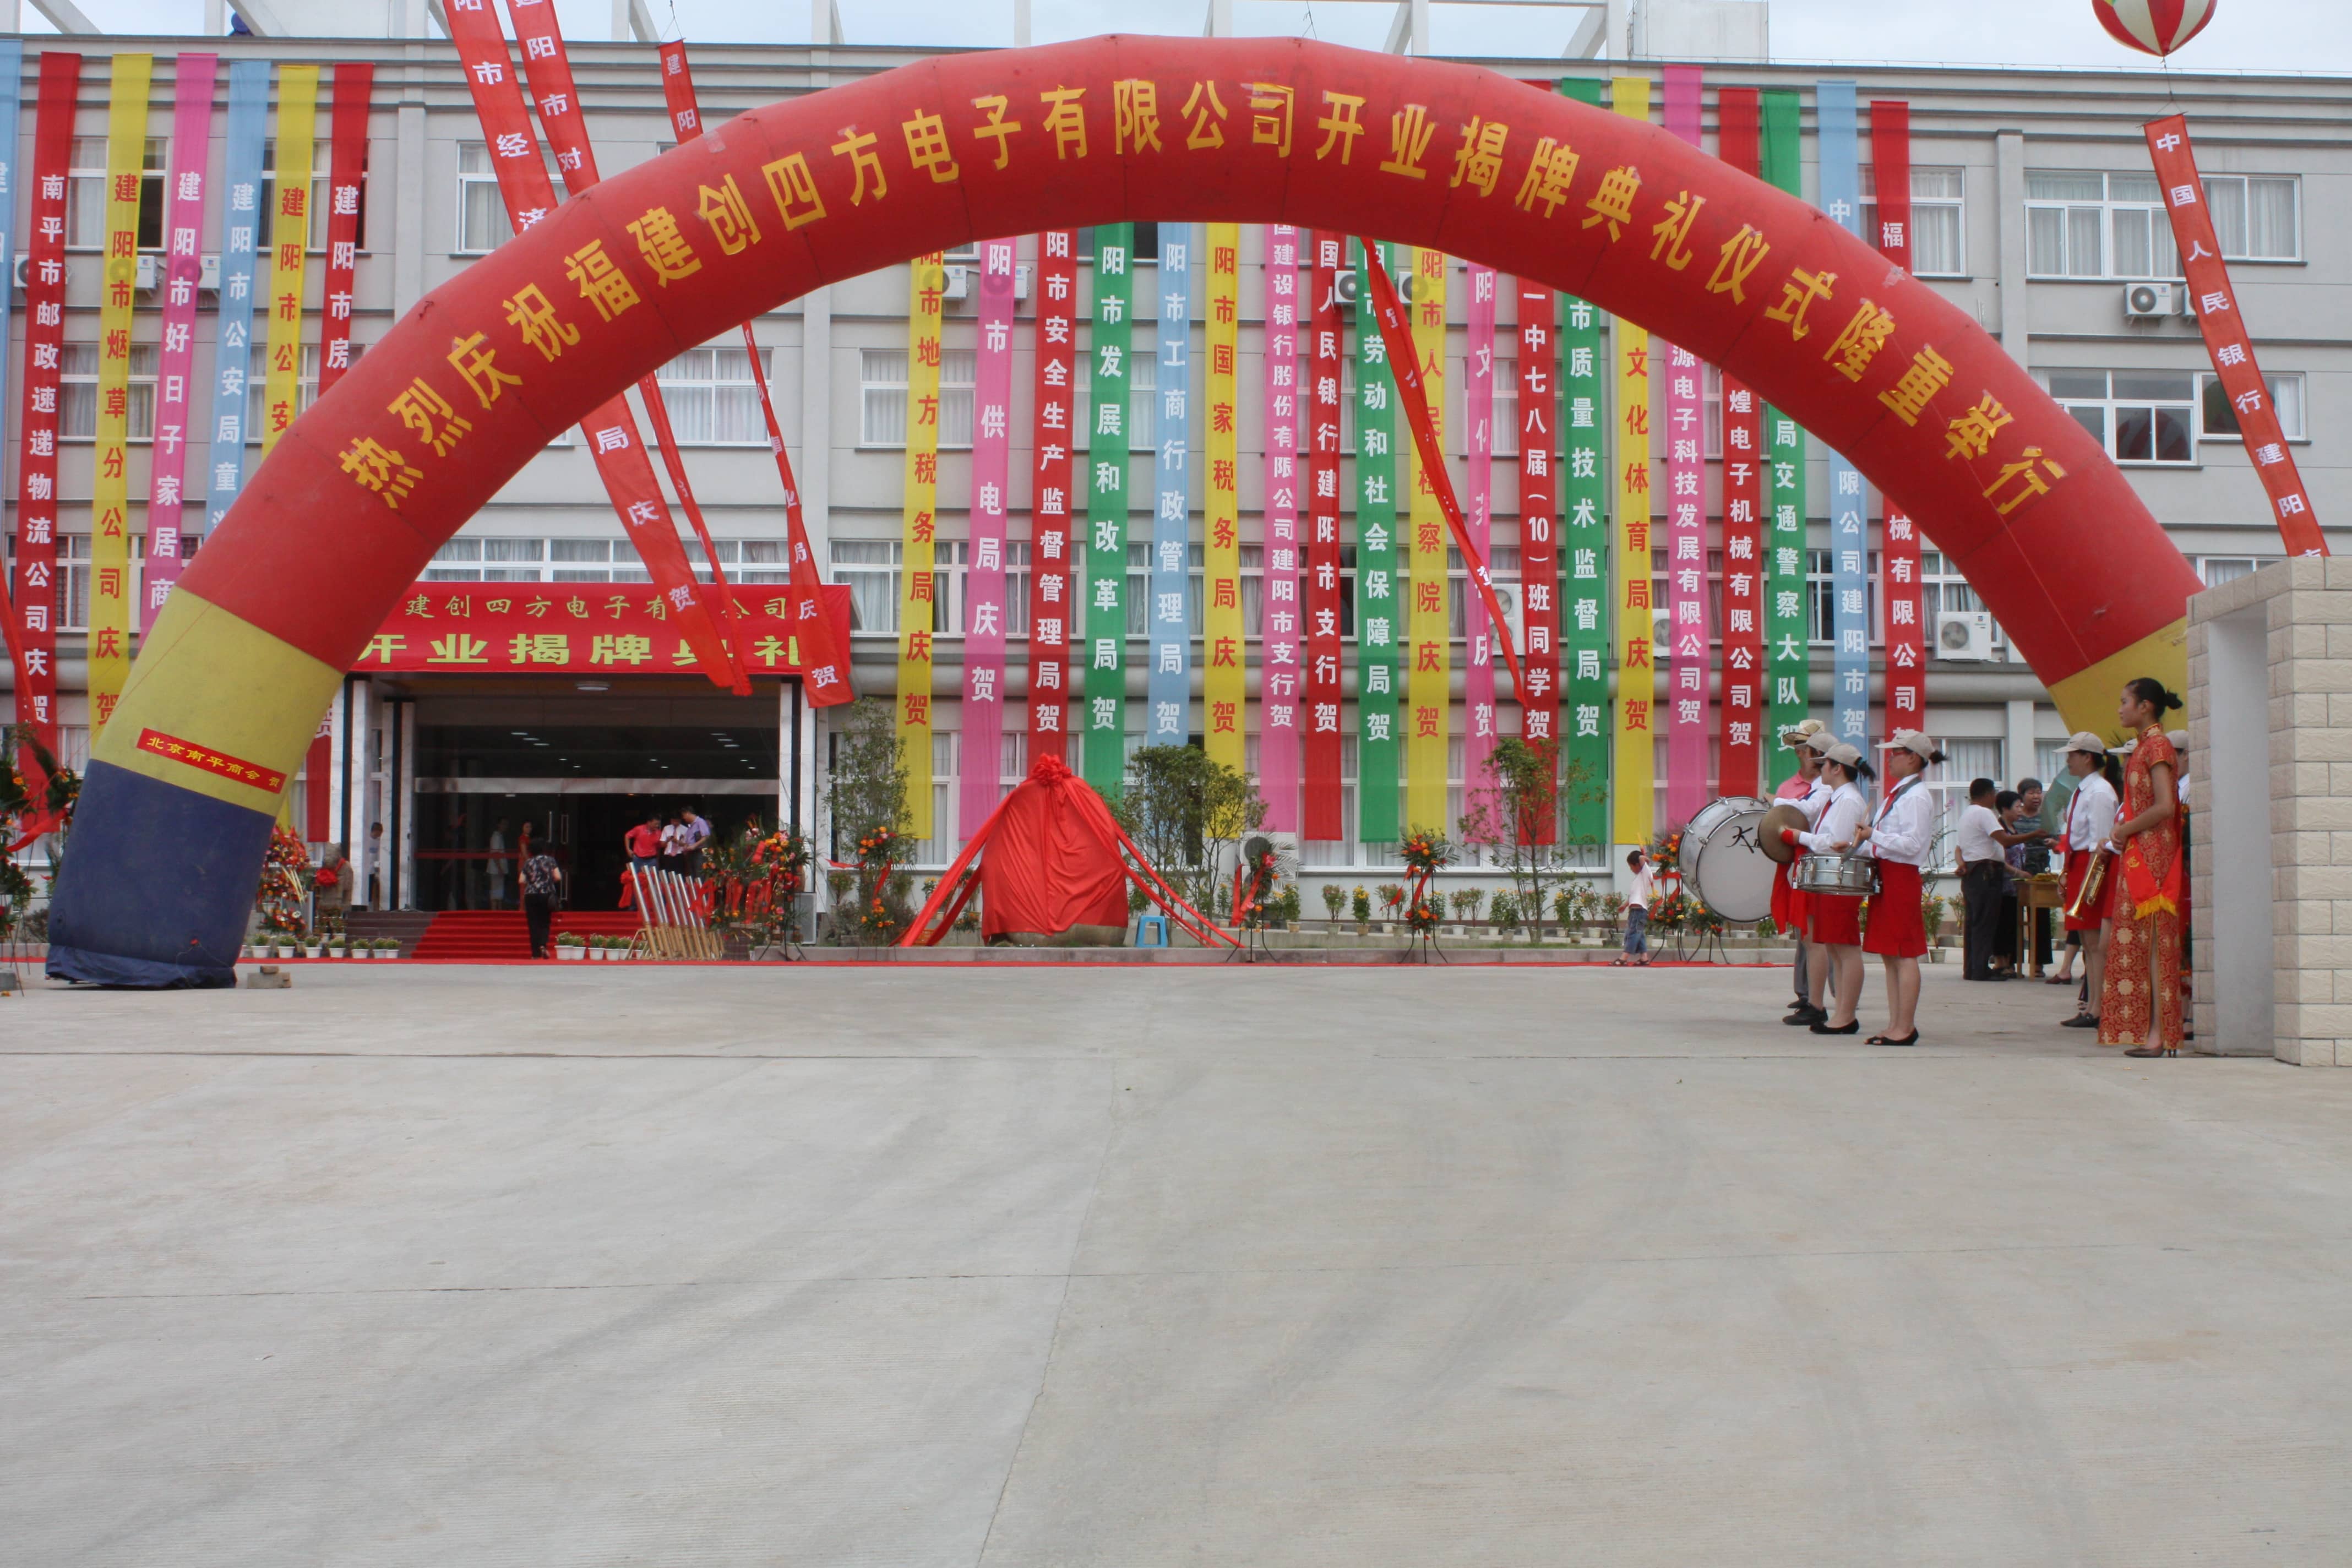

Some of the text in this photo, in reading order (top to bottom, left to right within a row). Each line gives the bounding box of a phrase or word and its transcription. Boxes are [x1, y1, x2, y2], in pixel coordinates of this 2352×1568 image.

[515, 0, 582, 172] 阳市对
[666, 53, 697, 132] 建阳
[1883, 222, 1903, 247] 福
[327, 185, 358, 368] 建阳市房
[596, 426, 696, 612] 局庆贺
[972, 244, 1011, 702] 阳市供电局庆贺
[1036, 231, 1069, 732] 阳市安全生产监督管理局贺
[1092, 246, 1124, 730] 阳市发展和改革局贺
[1157, 243, 1186, 735] 阳市工商行政管理局贺
[1212, 246, 1237, 733] 阳市国家税务局庆贺
[1570, 301, 1600, 737] 市质量技术监督局贺
[1625, 347, 1649, 731] 文化体育局庆贺
[1729, 390, 1754, 745] 煌电子机械有限公司贺
[1838, 471, 1866, 738] 限公司建阳市贺
[146, 737, 260, 780] 北京南平商会
